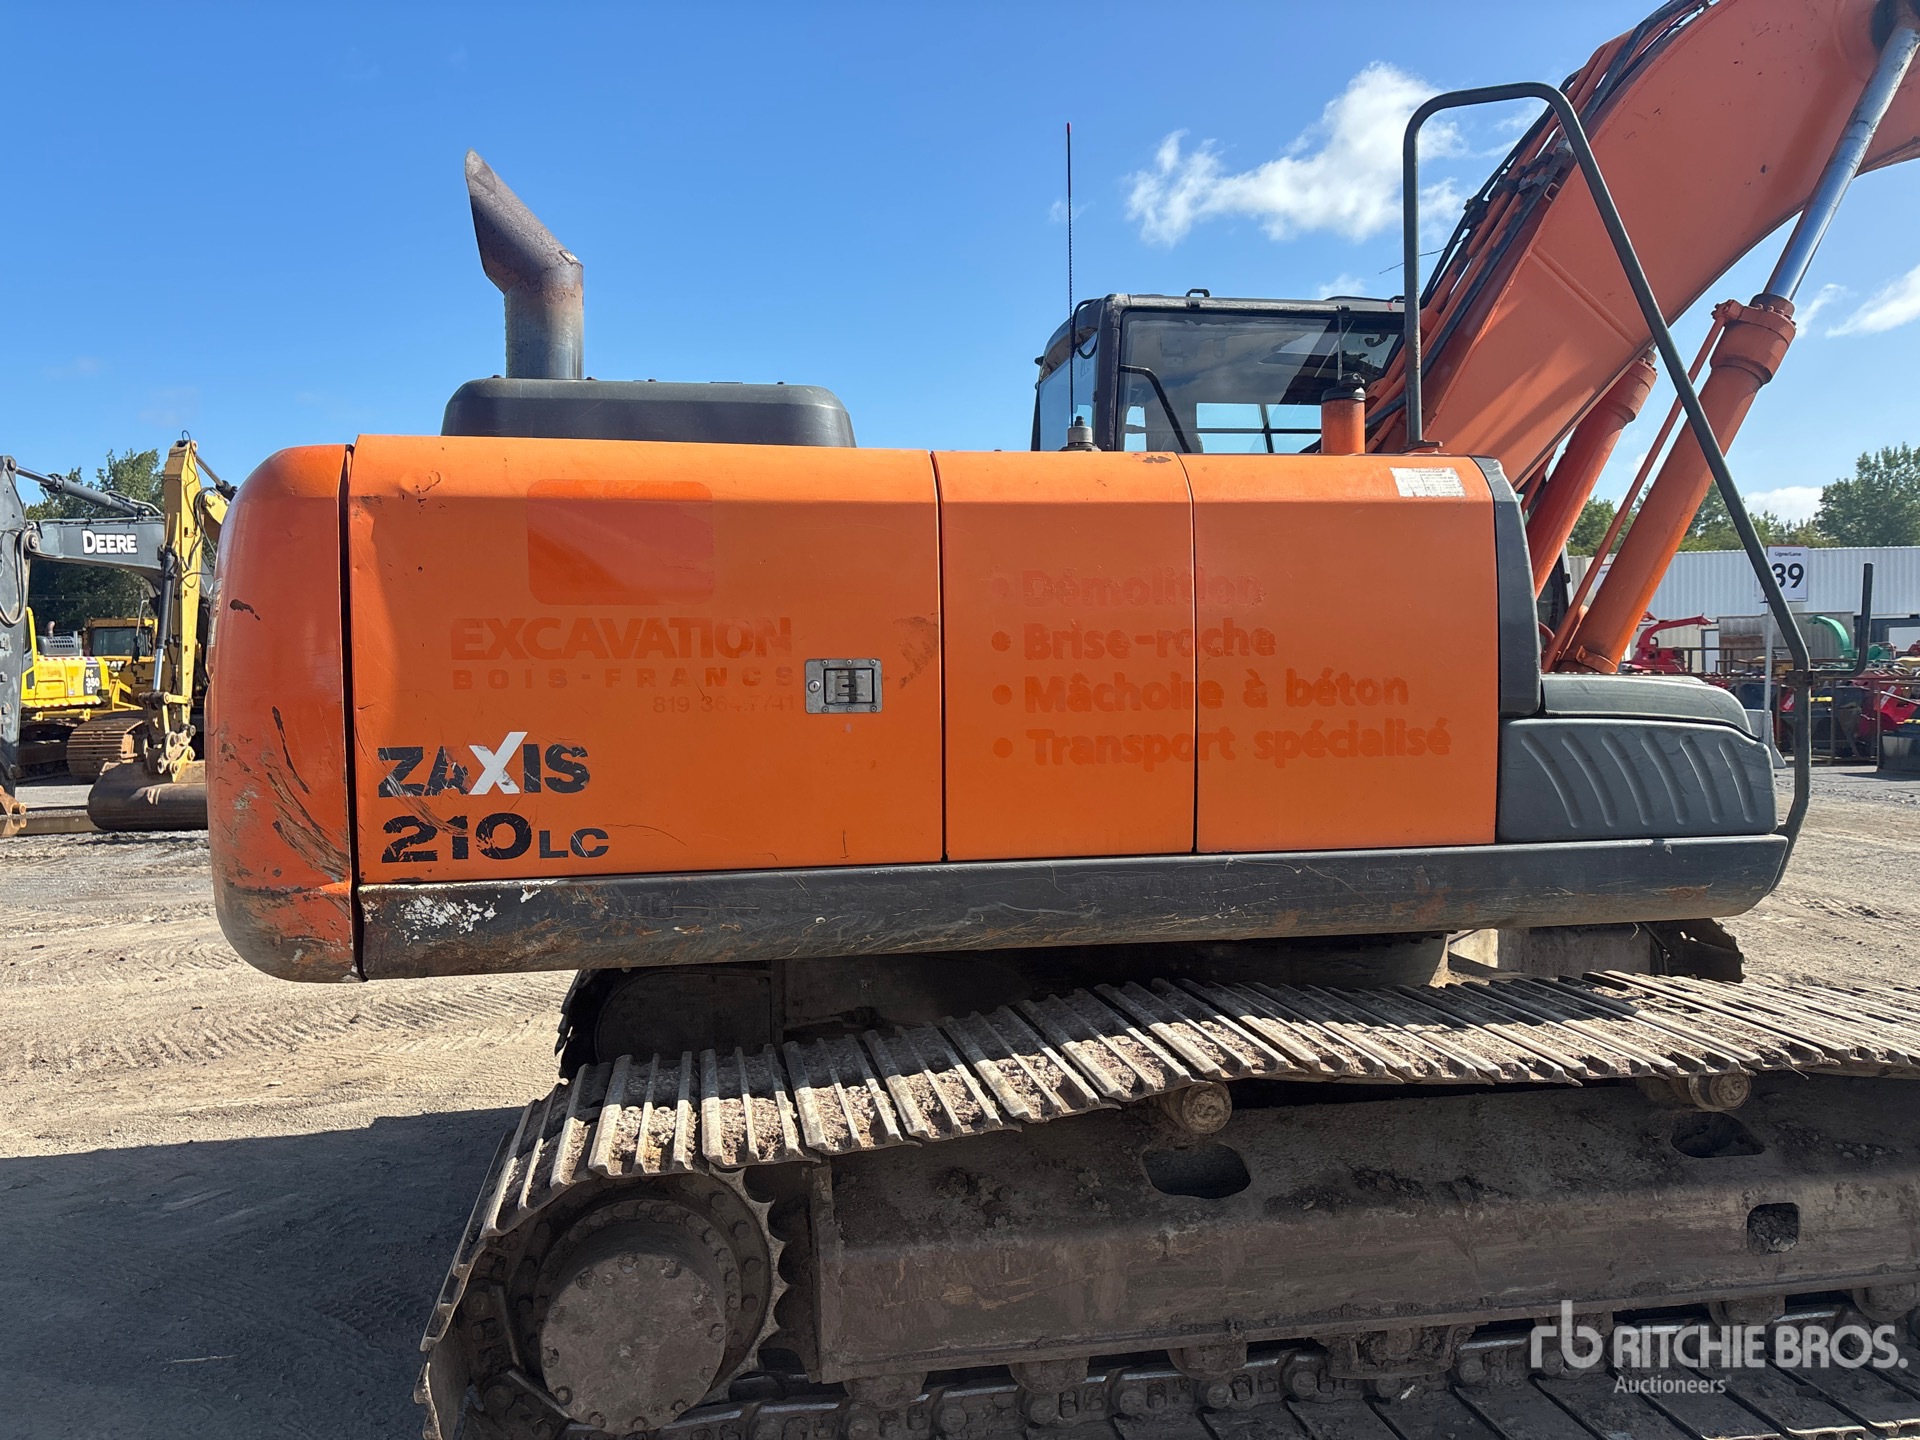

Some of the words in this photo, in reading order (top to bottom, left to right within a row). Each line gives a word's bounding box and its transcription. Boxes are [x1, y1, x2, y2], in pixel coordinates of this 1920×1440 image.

[82, 529, 138, 555] DEERE
[1771, 563, 1804, 588] 39
[450, 617, 793, 661] EXCAVATION
[1023, 617, 1277, 660] Brise-roche
[85, 677, 100, 688] 350
[1024, 670, 1225, 713] Mâchoire
[1243, 669, 1268, 708] à
[1285, 667, 1409, 707] béton
[377, 731, 591, 798] ZAXIS
[1025, 725, 1237, 772] Transport
[1252, 716, 1453, 769] spécialisé
[381, 813, 533, 863] 210
[538, 828, 610, 859] LC
